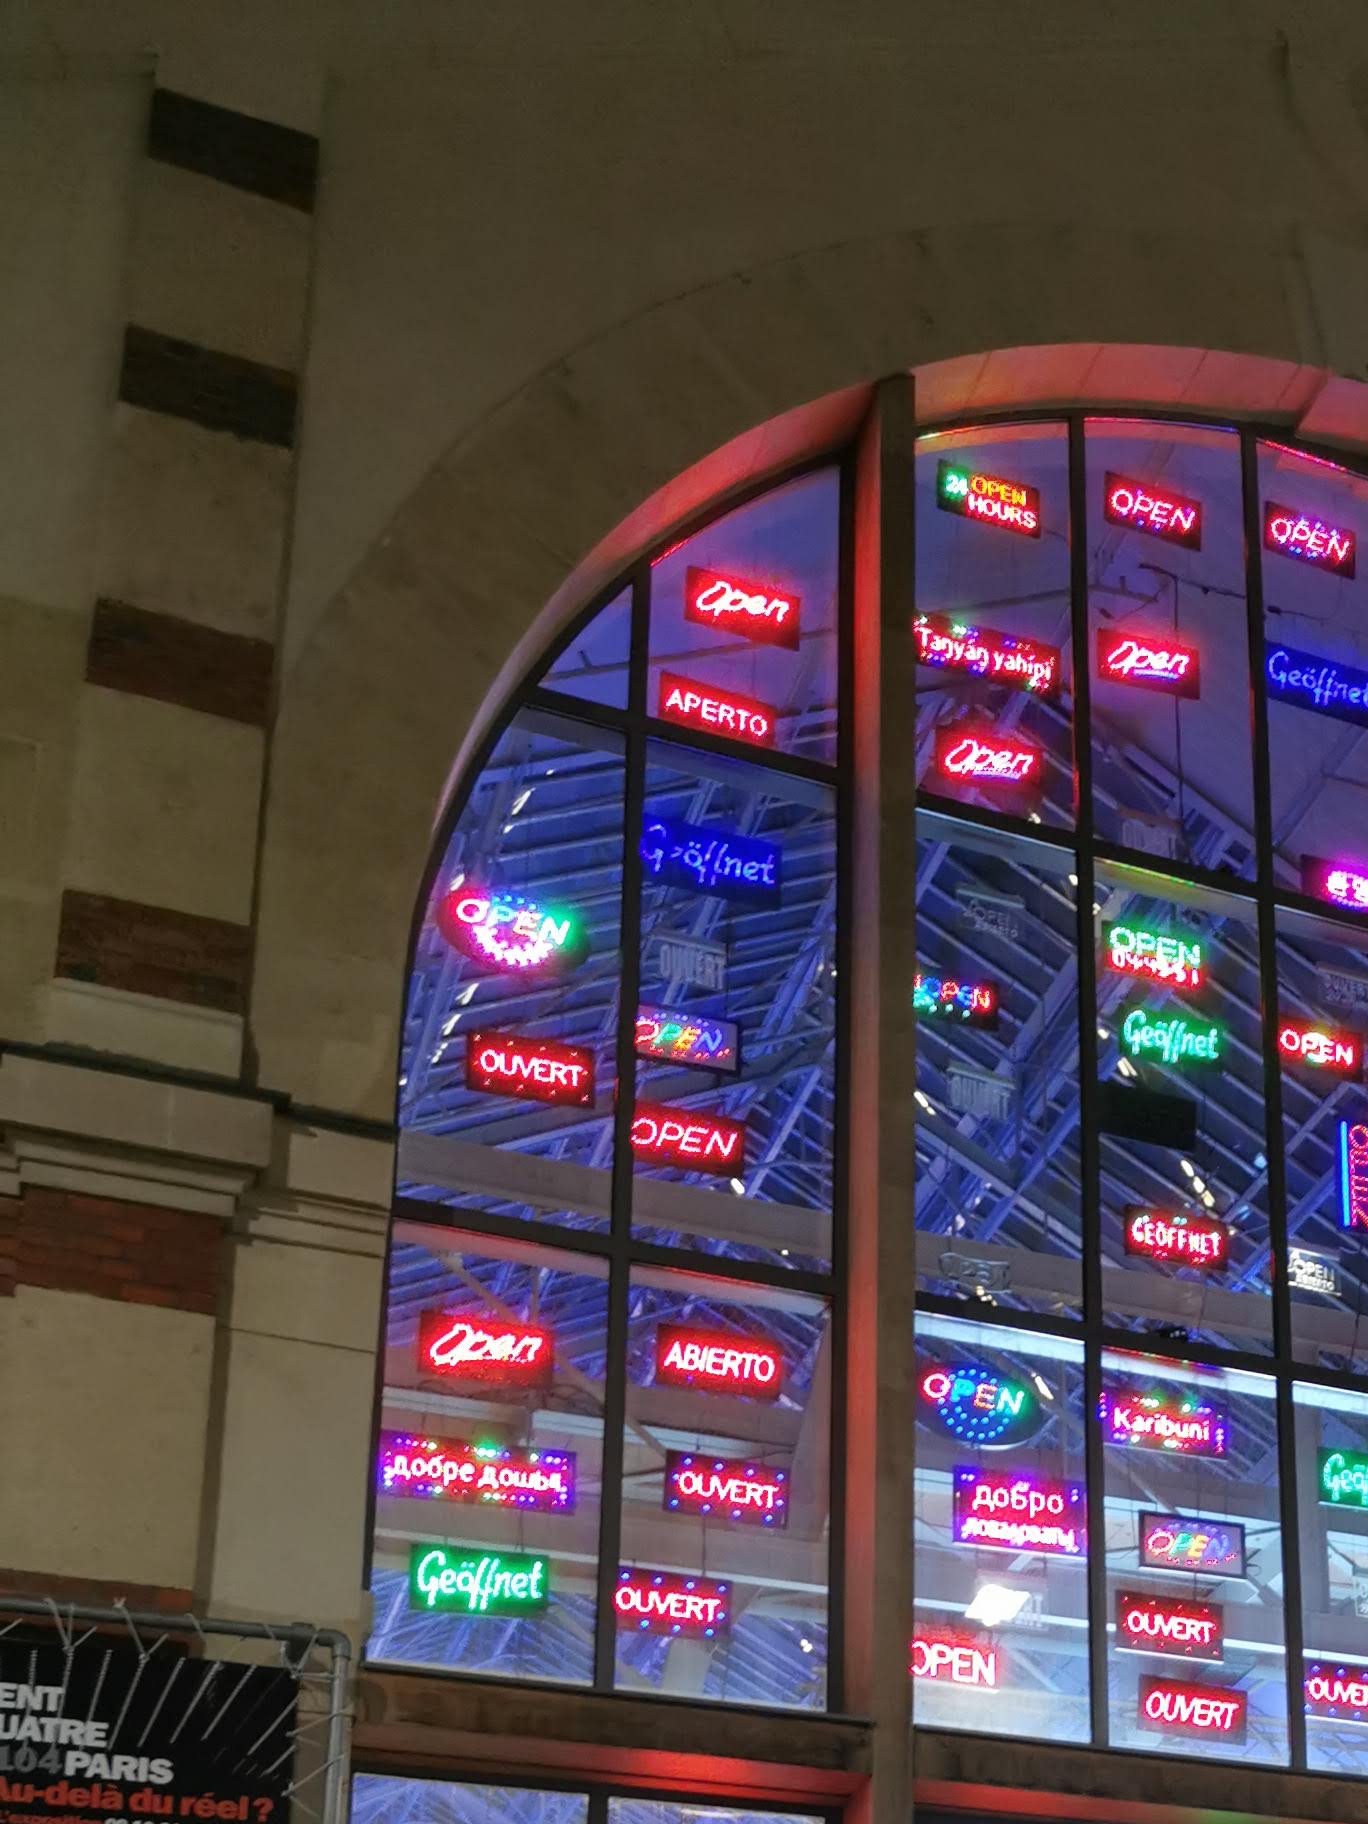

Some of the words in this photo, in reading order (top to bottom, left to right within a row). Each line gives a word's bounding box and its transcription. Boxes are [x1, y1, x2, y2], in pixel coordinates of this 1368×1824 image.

[945, 474, 968, 496] 24
[972, 476, 1027, 507] OPEN
[1110, 488, 1195, 530] OPEN
[968, 493, 1037, 529] HOURS
[1271, 516, 1350, 560] OPEN
[696, 580, 789, 623] Open
[1107, 641, 1190, 676] Open
[666, 689, 768, 736] APERTO
[944, 738, 1035, 776] Open
[640, 823, 775, 885] Göffnet
[456, 899, 570, 946] OPEN
[1110, 927, 1200, 968] OPEN
[1123, 1010, 1219, 1063] Geöffnet
[1281, 1030, 1353, 1066] OPEN
[480, 1050, 584, 1087] OUVERT
[430, 1324, 542, 1366] Open
[664, 1341, 774, 1382] ABIERTO
[924, 1372, 1024, 1414] OPEN
[1113, 1407, 1210, 1442] Karibuni
[679, 1472, 778, 1509] OUVERT
[1148, 1528, 1229, 1557] OPEN
[418, 1551, 542, 1610] Geöffnet
[615, 1587, 720, 1622] OUVERT
[1128, 1611, 1214, 1643] OUVERT
[1146, 1691, 1238, 1730] OUVERT
[64, 1750, 175, 1784] PARIS
[0, 1776, 124, 1810] Au-delà
[129, 1787, 173, 1816] du
[180, 1791, 249, 1821] réel
